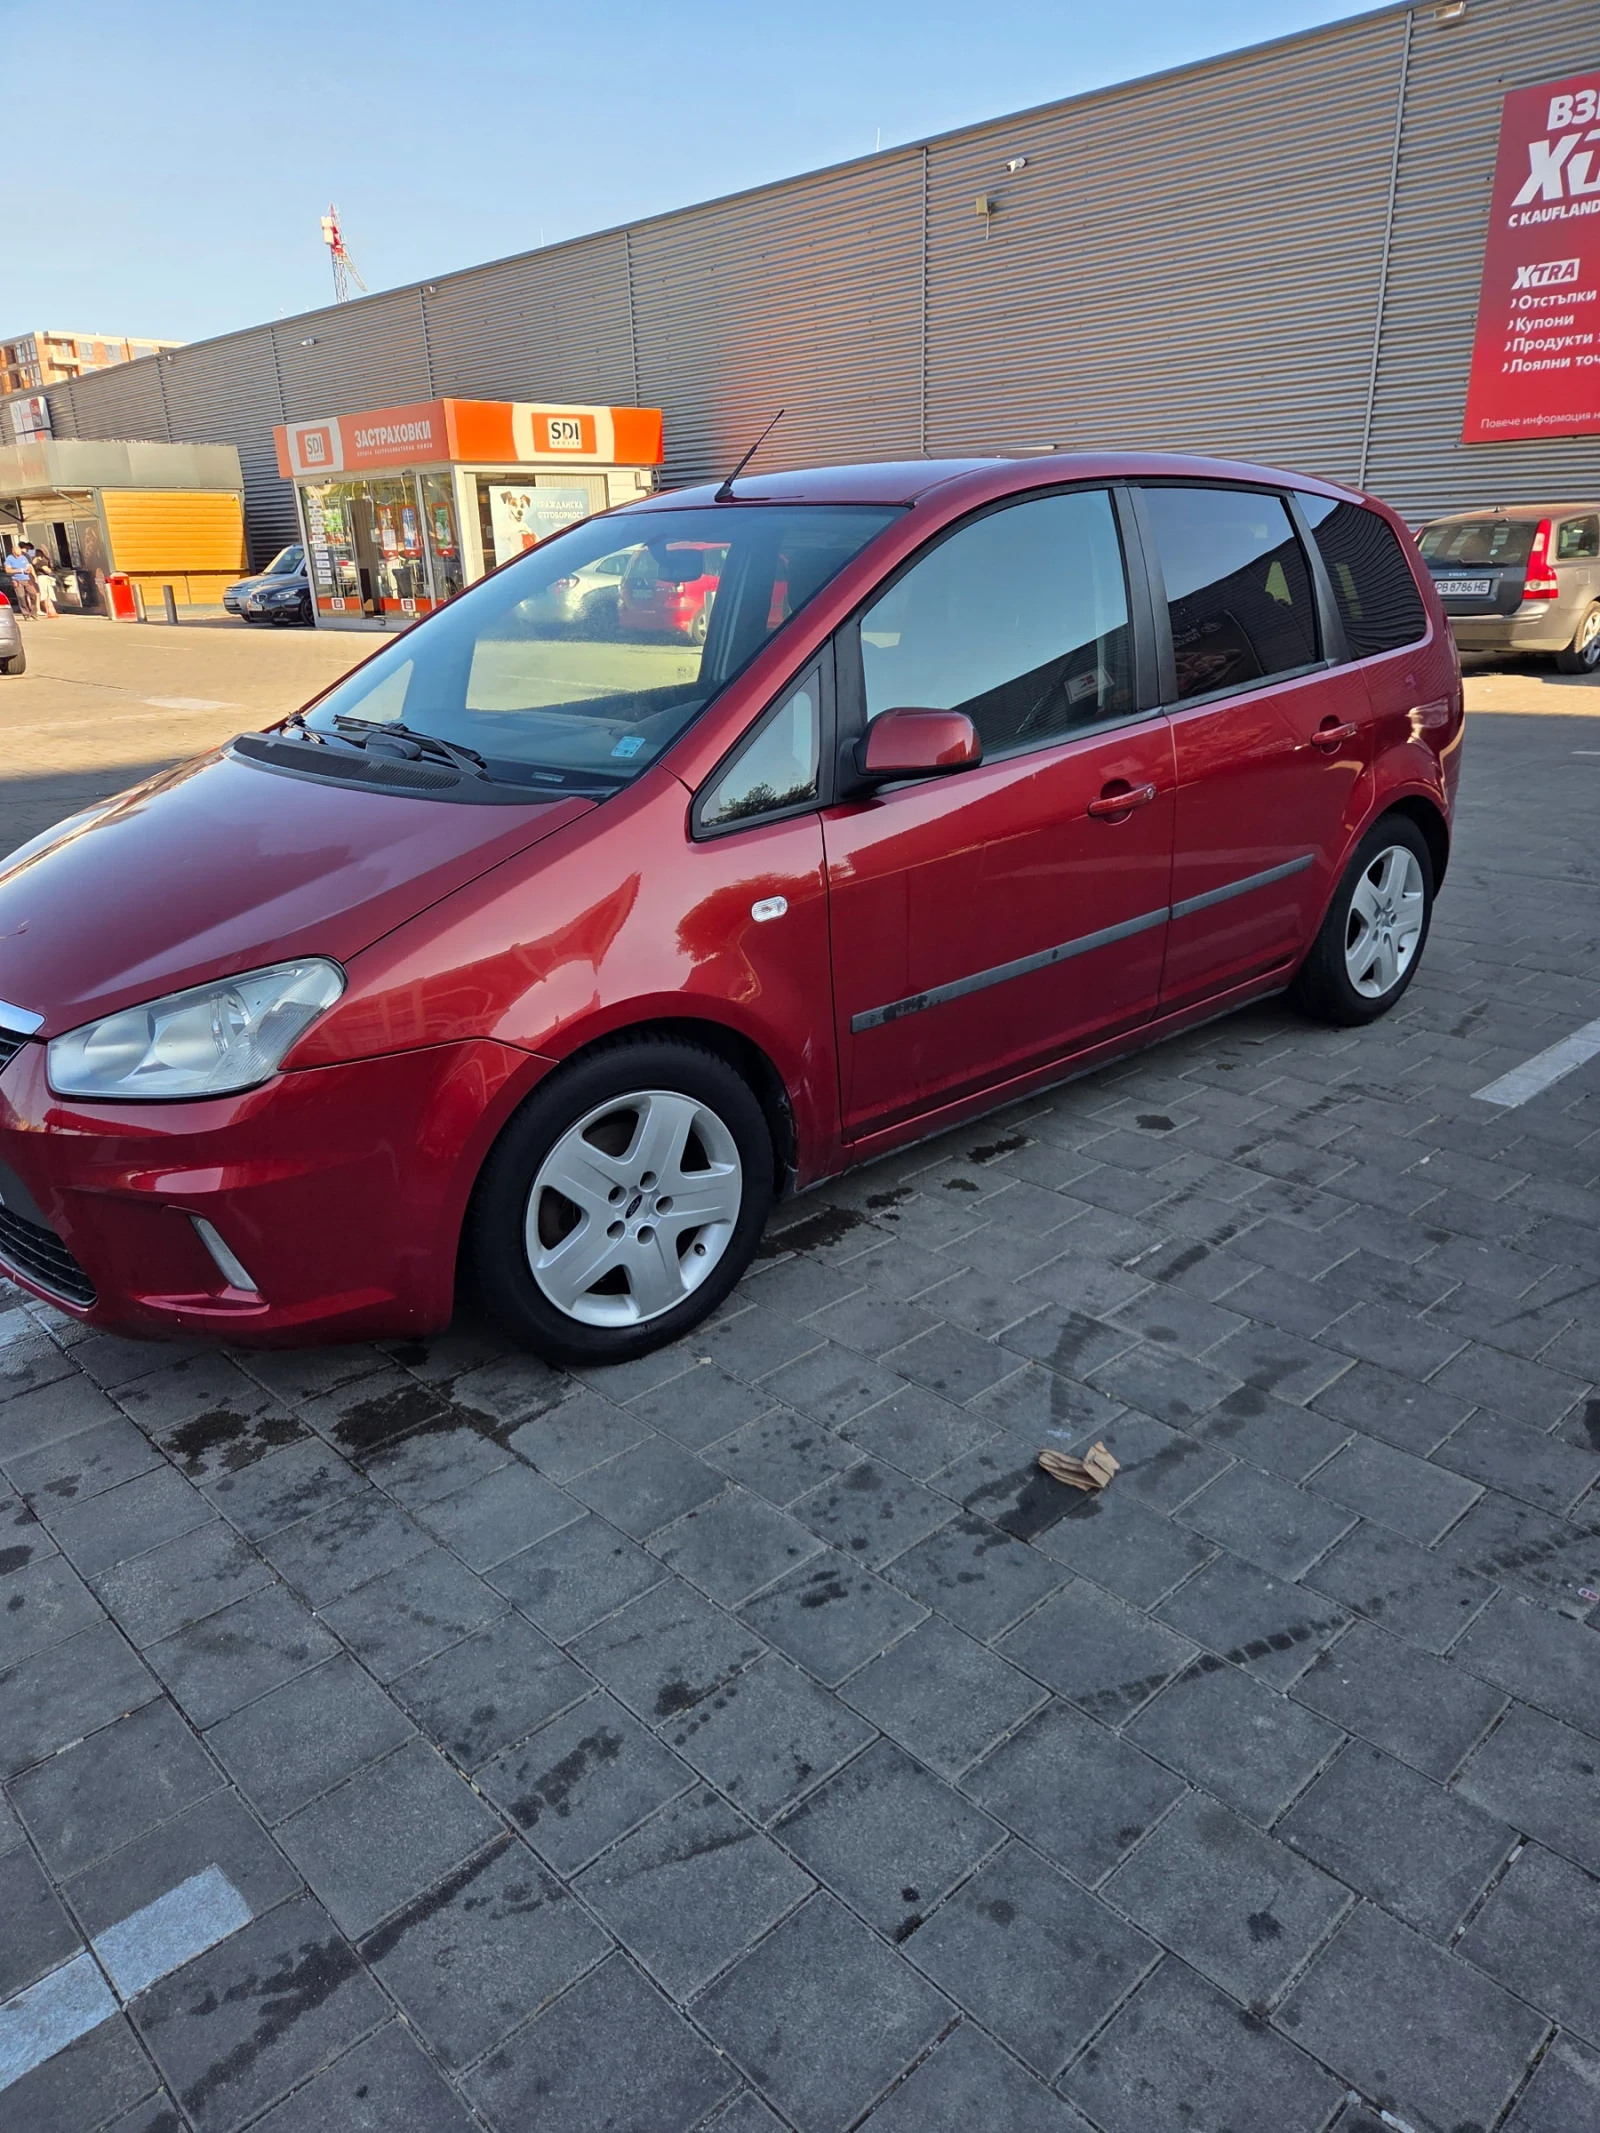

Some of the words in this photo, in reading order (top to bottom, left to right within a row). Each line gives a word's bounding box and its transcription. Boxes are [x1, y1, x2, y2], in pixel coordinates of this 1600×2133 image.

[1546, 88, 1600, 131] ВЗ
[1520, 199, 1600, 226] KAUFLAND
[1510, 258, 1580, 290] XTRA
[1518, 289, 1597, 310] Отстъпки
[1515, 314, 1575, 334] Купони
[1512, 333, 1594, 354] Продукти
[1509, 357, 1571, 374] Лоялни
[551, 421, 579, 440] SDI
[1480, 417, 1521, 429] Повече
[1522, 412, 1592, 425] информация
[354, 420, 432, 448] ЗАСТРАХОВКИ
[306, 435, 323, 455] SDI
[1450, 582, 1473, 592] 8786
[1474, 581, 1488, 592] HE
